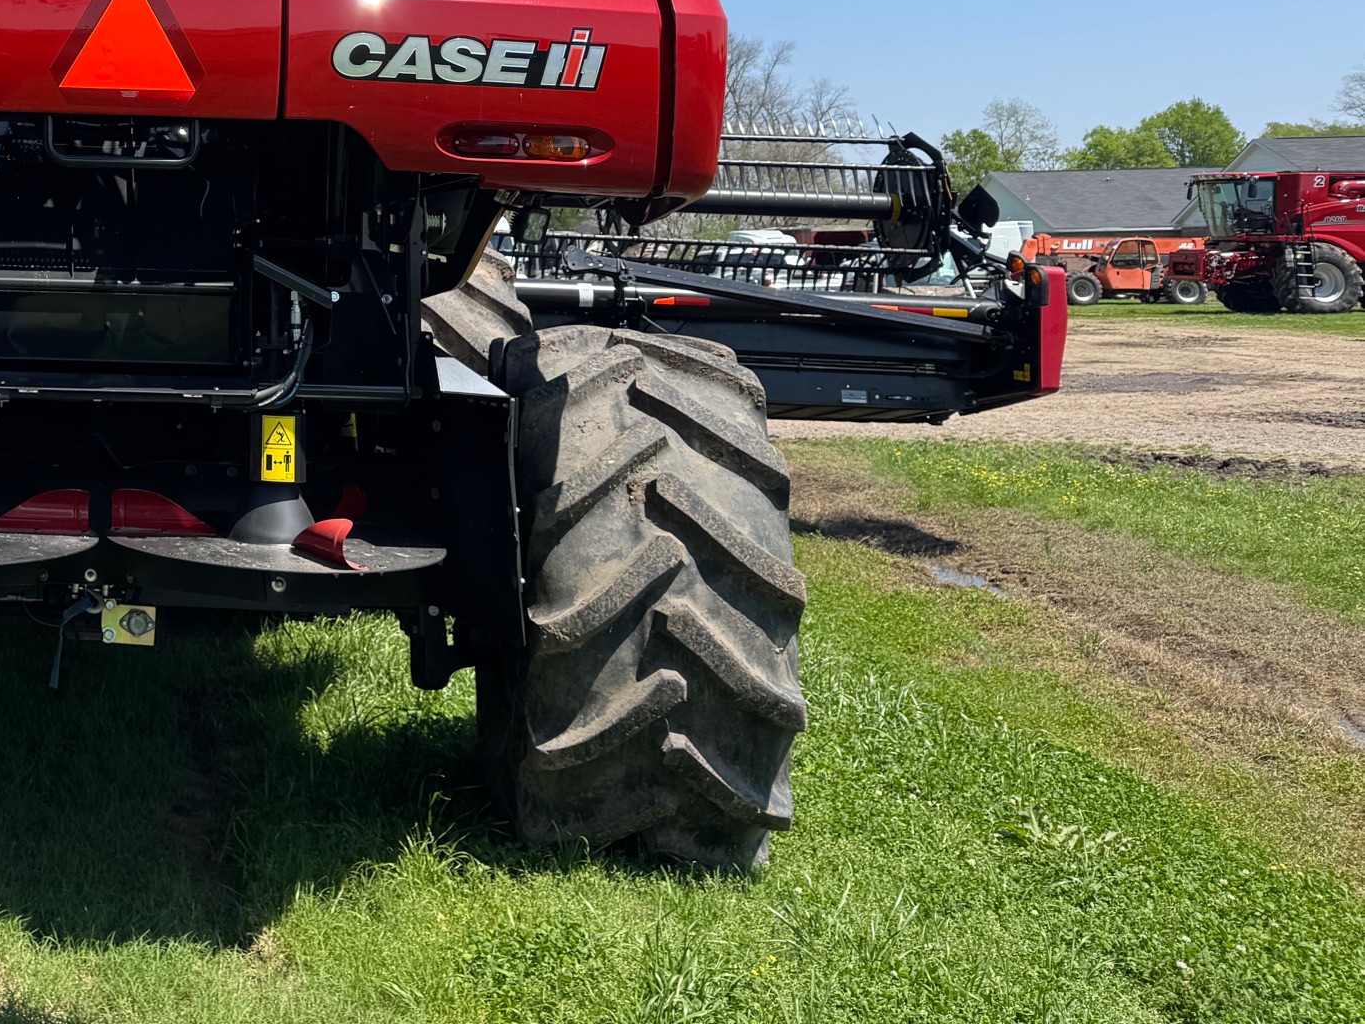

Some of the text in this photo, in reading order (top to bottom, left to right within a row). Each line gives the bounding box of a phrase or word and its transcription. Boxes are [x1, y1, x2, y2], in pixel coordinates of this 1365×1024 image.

[332, 31, 536, 85] CASE
[1313, 175, 1326, 188] 2
[1062, 239, 1093, 250] Lull
